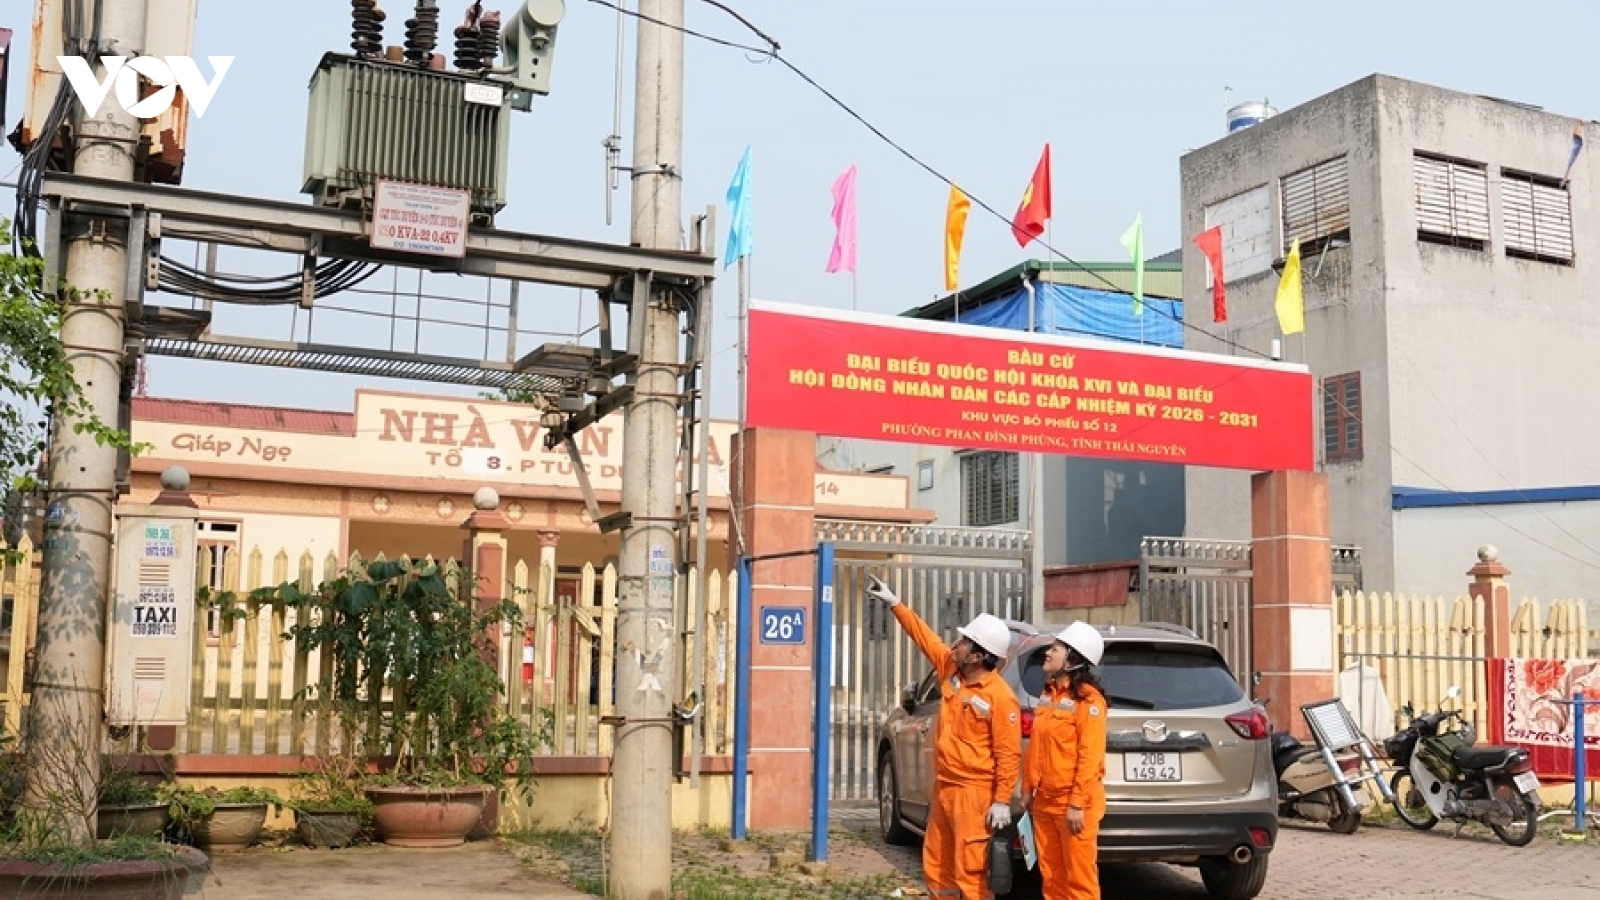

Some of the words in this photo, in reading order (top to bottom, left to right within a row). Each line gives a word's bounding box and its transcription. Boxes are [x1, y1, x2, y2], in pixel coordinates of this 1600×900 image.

[1008, 347, 1044, 366] BẦU
[1048, 352, 1076, 370] CỬ
[846, 353, 881, 372] ĐẠI
[887, 357, 931, 376] BIỂU
[937, 362, 988, 382] QUỐC
[994, 368, 1026, 387] HỘI
[1031, 373, 1079, 390] KHÓA
[1083, 377, 1112, 393] XVI
[1116, 379, 1140, 396] VÀ
[1143, 383, 1172, 401] ĐẠI
[1177, 385, 1214, 404] BIỂU
[789, 368, 825, 388] HỘI
[831, 371, 886, 393] ĐỒNG
[892, 380, 944, 398] NHÂN
[951, 385, 988, 403] DÂN
[994, 389, 1031, 407] CÁC
[1036, 391, 1071, 409] CẤP
[1076, 398, 1131, 416] NHIỆM
[1135, 402, 1157, 418] KỲ
[1161, 405, 1204, 421] 2026
[1219, 411, 1258, 427] 2031
[378, 405, 495, 449] NHÀ
[510, 418, 613, 457] VN
[962, 410, 989, 422] KHU
[992, 413, 1019, 427] VỰC
[1023, 414, 1042, 426] BỎ
[1045, 416, 1079, 431] PHIẾU
[1083, 418, 1100, 432] SỐ
[1103, 423, 1118, 433] 12
[171, 433, 232, 457] Giáp
[237, 436, 292, 462] Ngọ
[881, 422, 942, 438] PHƯỜNG
[945, 428, 982, 440] PHAN
[984, 430, 1018, 444] ĐÌNH
[1021, 434, 1069, 449] PHÙNG,
[1071, 437, 1101, 450] TỈNH
[1105, 440, 1135, 453] THÁI
[1137, 443, 1187, 456] NGUYÊN
[425, 447, 463, 467] TỔ
[815, 481, 840, 496] 14
[134, 605, 177, 622] TAXI
[765, 612, 802, 639] 26A
[1141, 752, 1165, 765] 20B
[1132, 767, 1176, 780] 149.42
